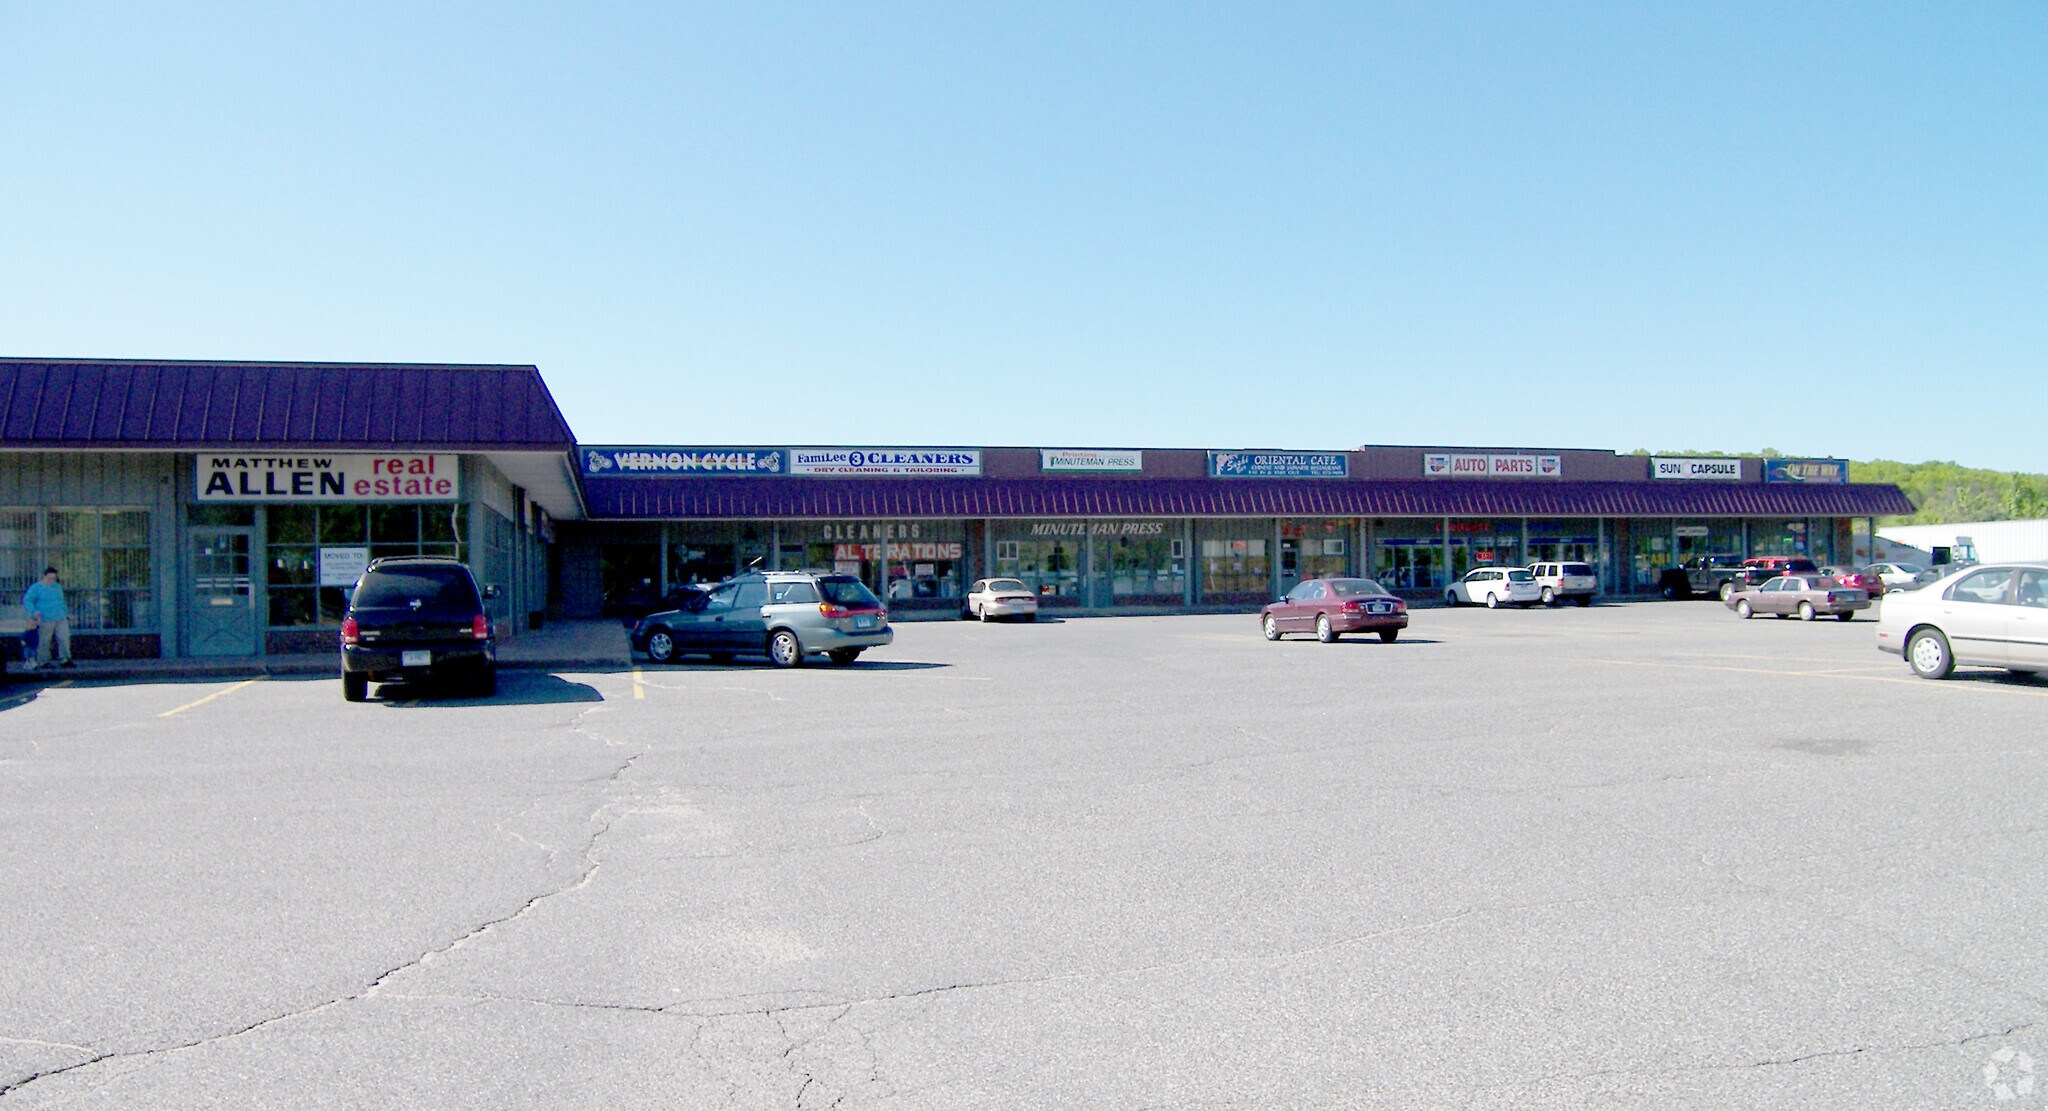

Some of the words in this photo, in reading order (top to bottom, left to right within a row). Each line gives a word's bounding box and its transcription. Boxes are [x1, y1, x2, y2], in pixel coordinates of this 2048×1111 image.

[614, 452, 697, 471] VERNON
[701, 452, 756, 471] CYCLE
[868, 452, 973, 464] CLEANERS
[1054, 458, 1104, 466] MINUTEMAN
[1254, 455, 1306, 465] ORIENTAL
[1310, 456, 1337, 465] CAFE
[1454, 458, 1486, 471] AUTO
[1495, 459, 1533, 472] PARTS
[212, 458, 333, 469] MATTHEW
[373, 456, 435, 475] real
[1660, 464, 1681, 474] SUN
[1691, 464, 1736, 474] CAPSULE
[205, 471, 345, 496] ALLEN
[353, 475, 452, 496] estate
[823, 524, 920, 539] CLEANERS
[1120, 523, 1163, 535] PRESS
[835, 543, 962, 560] ALTERATIONS
